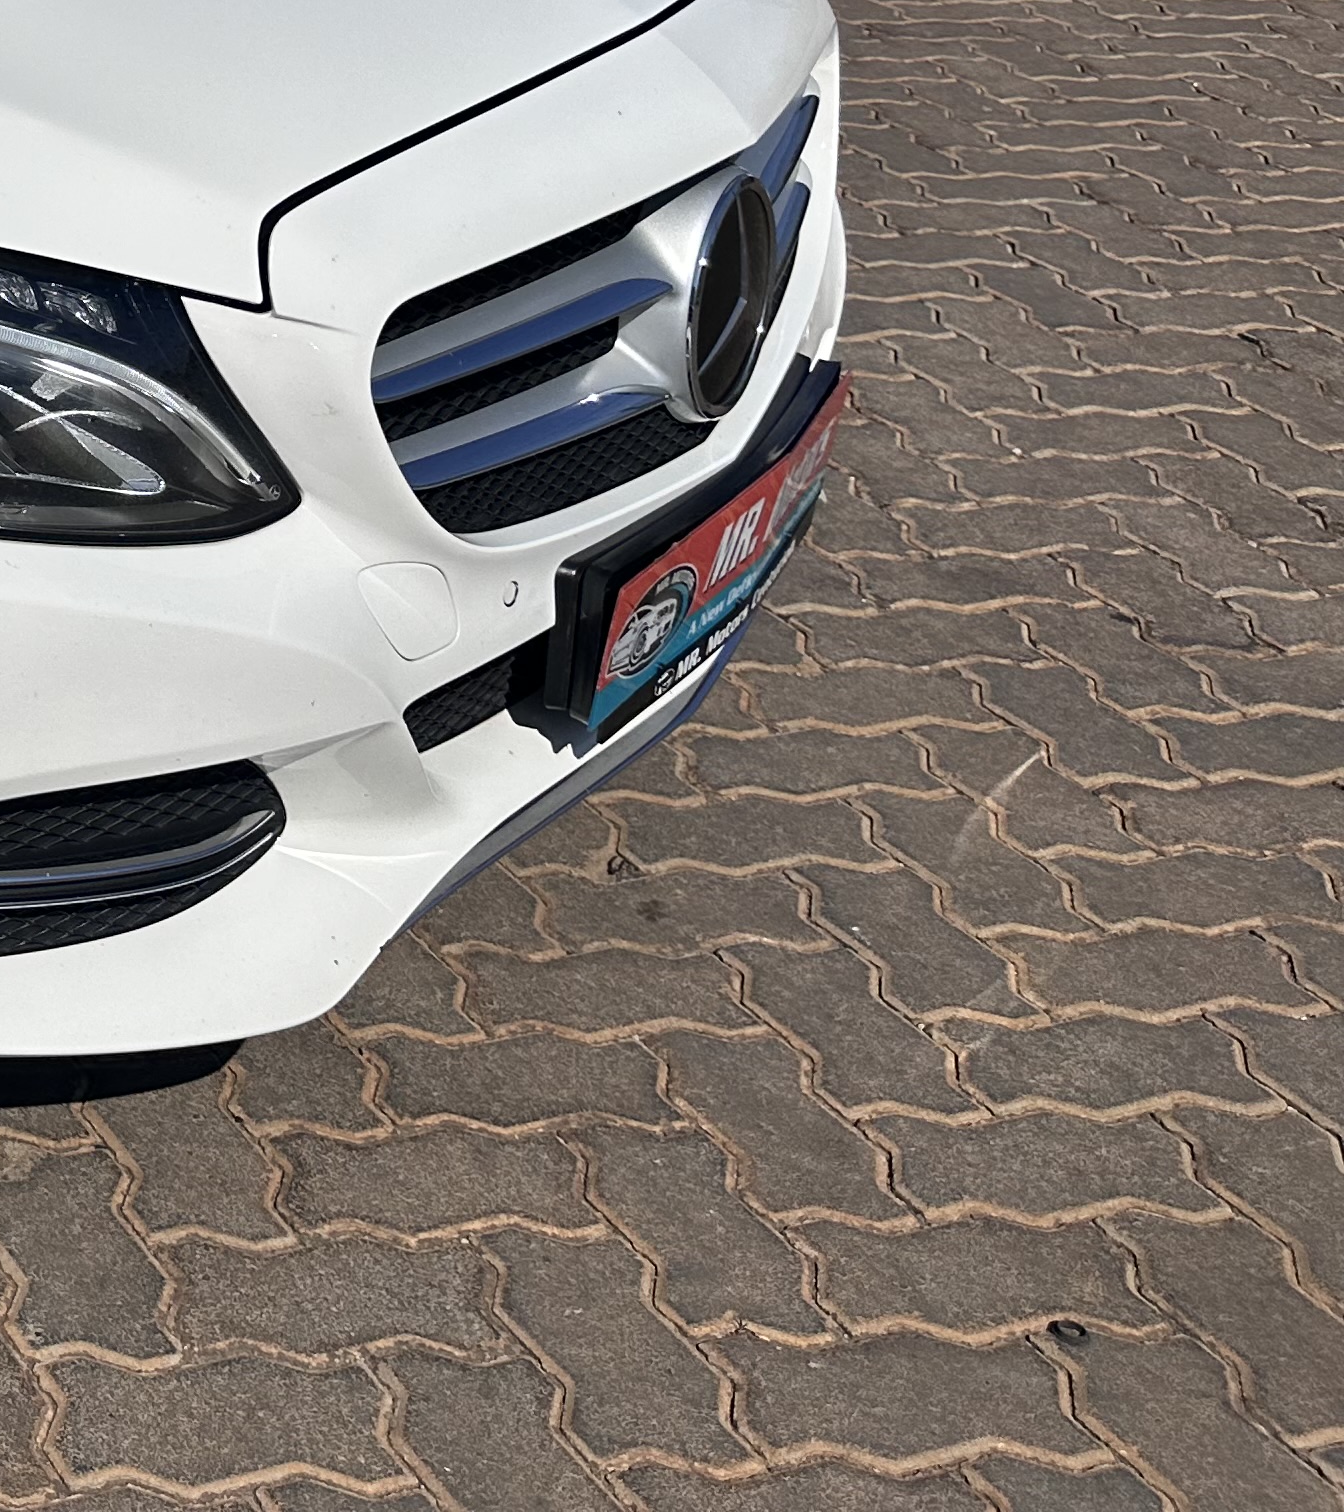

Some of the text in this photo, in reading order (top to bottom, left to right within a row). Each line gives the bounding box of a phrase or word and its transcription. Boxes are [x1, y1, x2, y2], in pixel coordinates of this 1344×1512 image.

[702, 496, 767, 594] MR.
[674, 646, 702, 682] MR.
[704, 602, 750, 658] Motors
